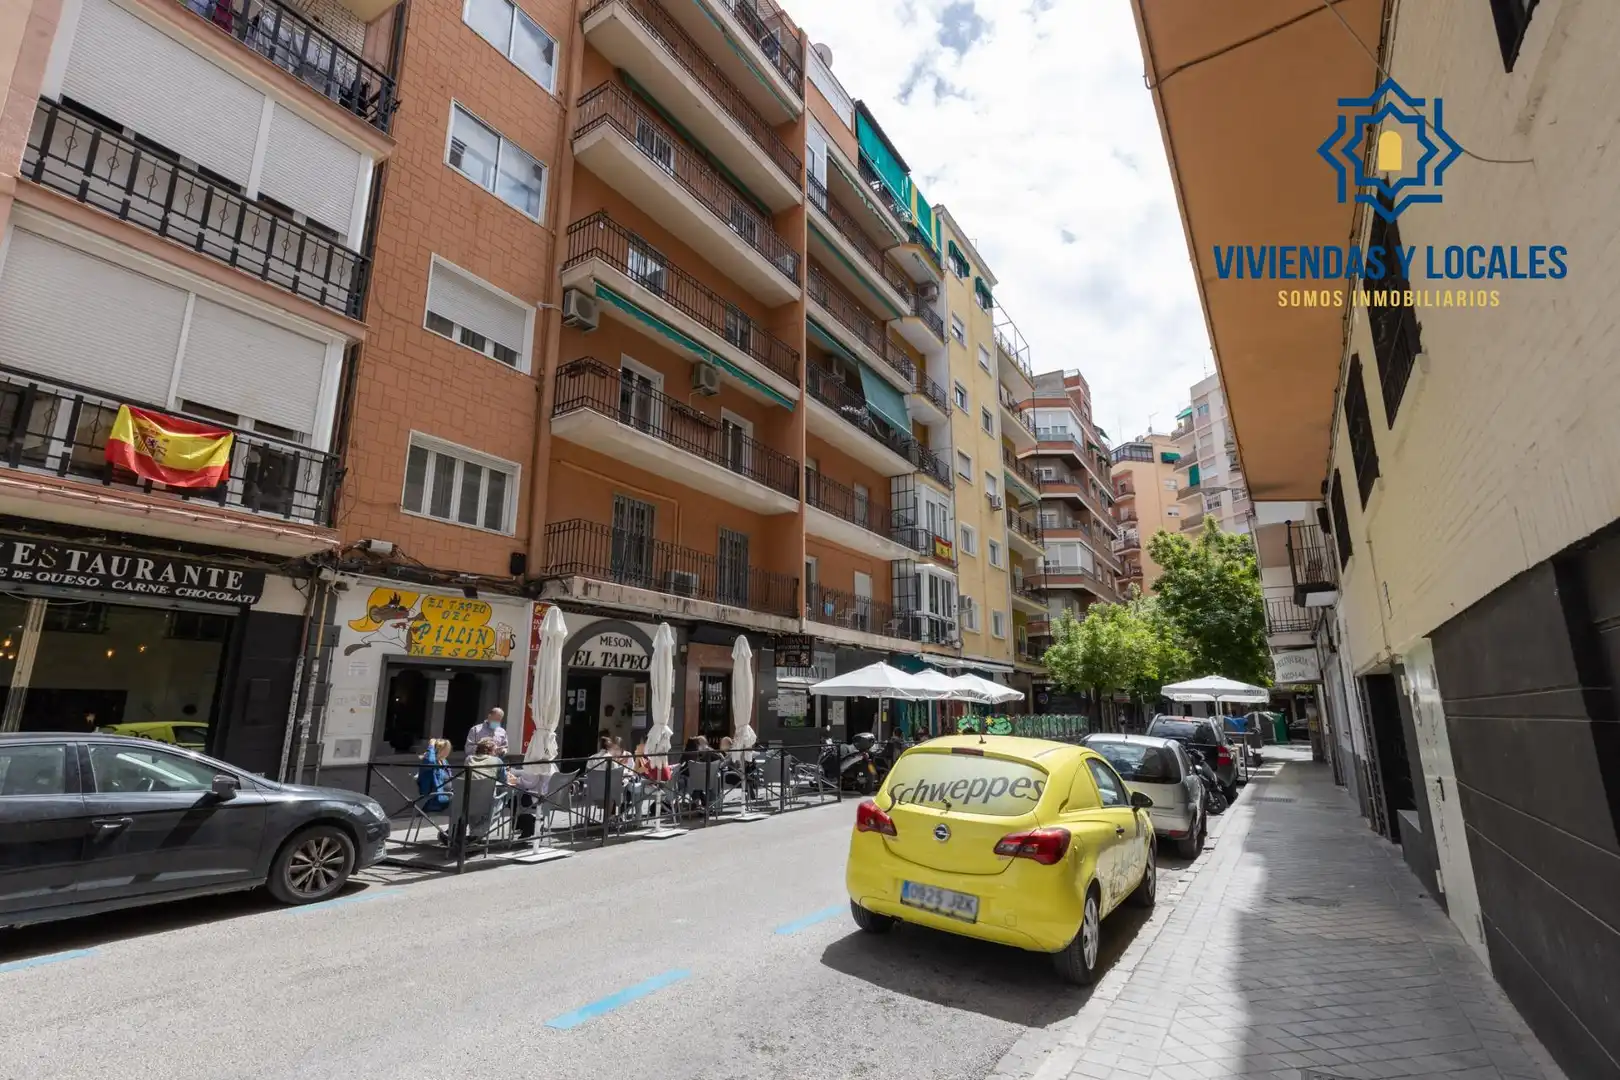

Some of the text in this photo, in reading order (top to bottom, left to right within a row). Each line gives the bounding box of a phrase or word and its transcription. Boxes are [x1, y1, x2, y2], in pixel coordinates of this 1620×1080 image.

[0, 541, 243, 591] ESTAURANTE
[12, 570, 33, 580] DE
[427, 597, 487, 614] EL TAPEO
[441, 610, 471, 622] DEL
[600, 636, 632, 648] MESON
[572, 650, 650, 670] EL TAPEO
[884, 776, 1047, 813] Schweppes
